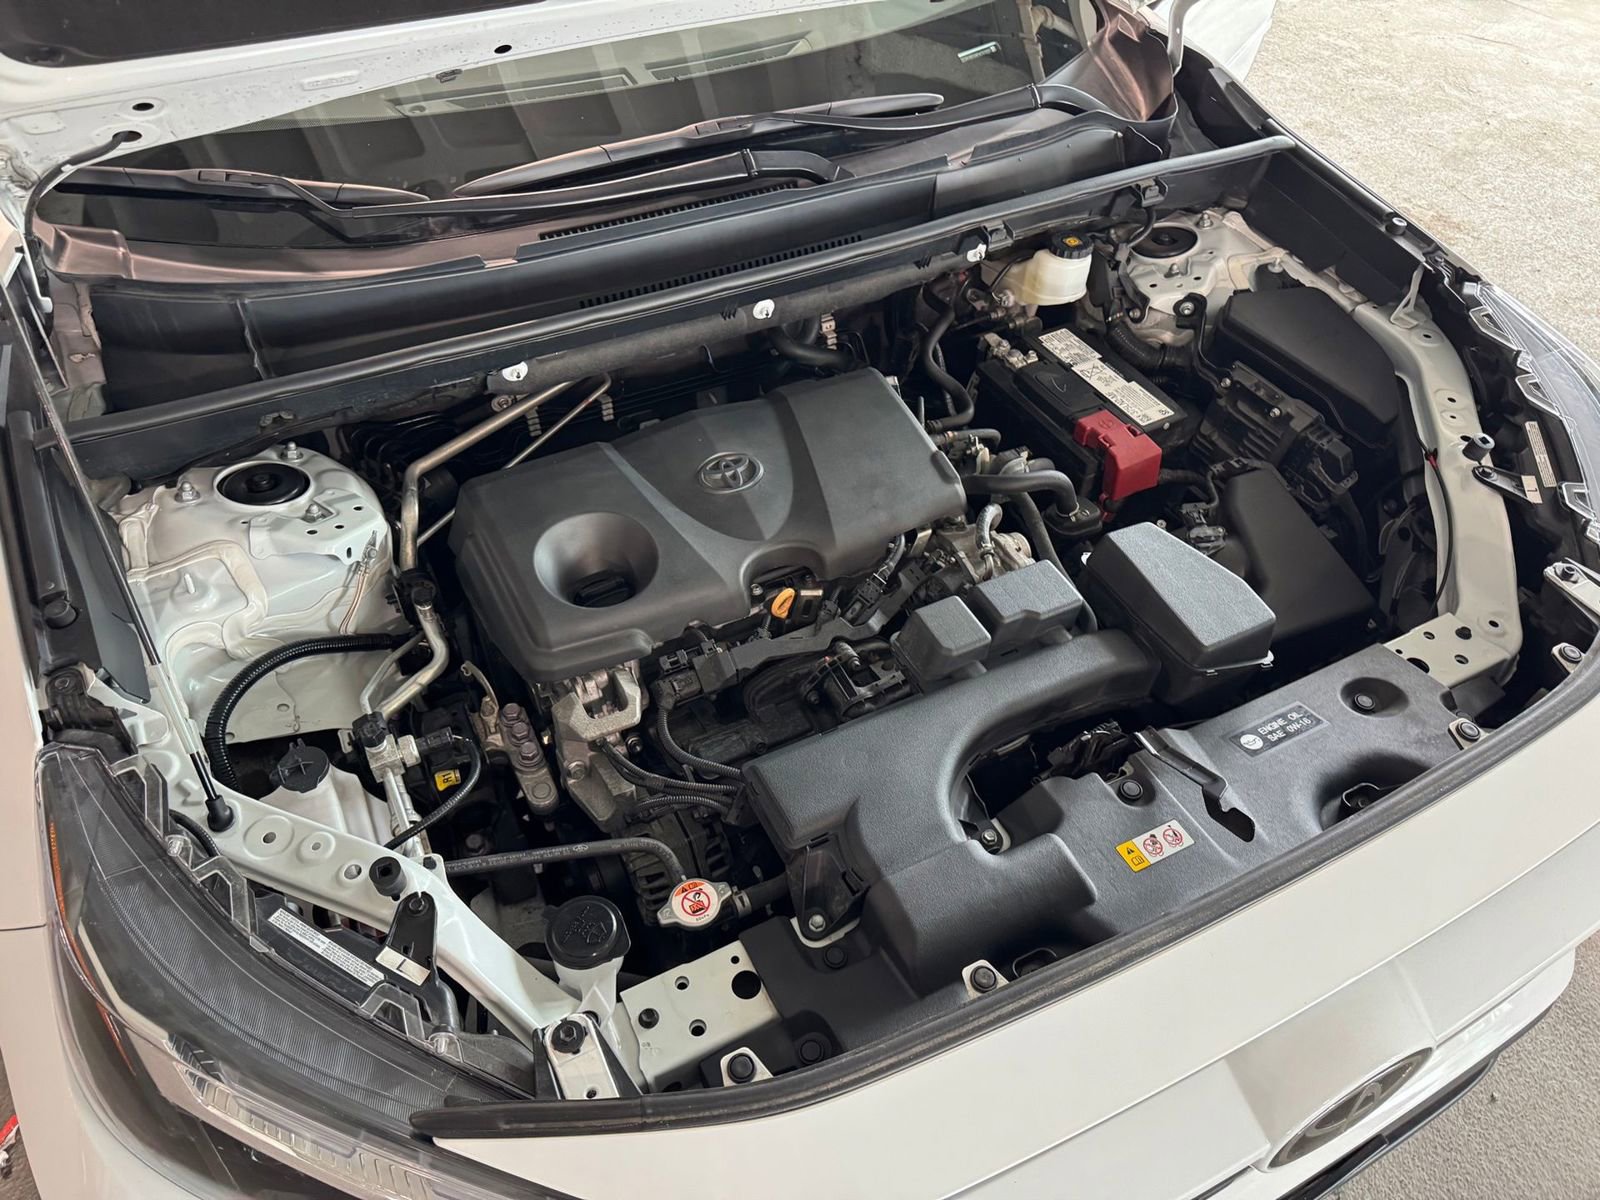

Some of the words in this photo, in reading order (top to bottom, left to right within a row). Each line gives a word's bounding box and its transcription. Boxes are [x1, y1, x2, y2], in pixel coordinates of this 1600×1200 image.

[1257, 717, 1287, 735] ENGINE
[1287, 711, 1303, 721] OIL
[1267, 729, 1286, 742] SAE
